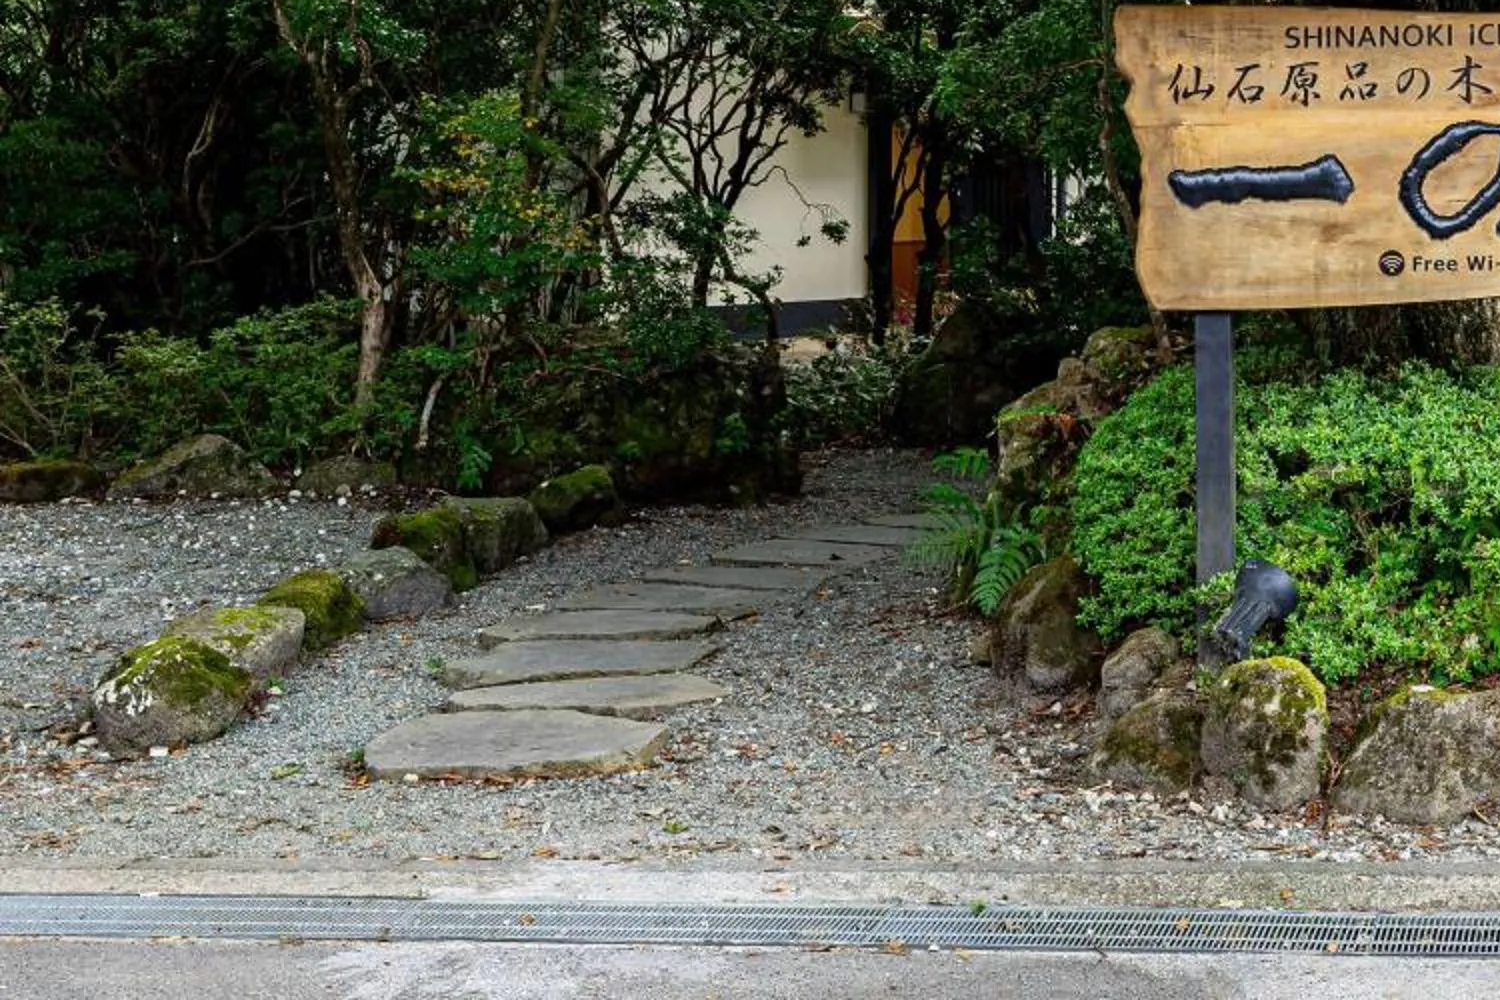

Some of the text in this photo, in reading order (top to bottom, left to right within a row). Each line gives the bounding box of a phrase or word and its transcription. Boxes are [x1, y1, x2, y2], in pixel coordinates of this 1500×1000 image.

[1284, 24, 1454, 49] SHINANOKI
[1167, 55, 1493, 107] 仙石原品の木
[1412, 255, 1458, 272] Free
